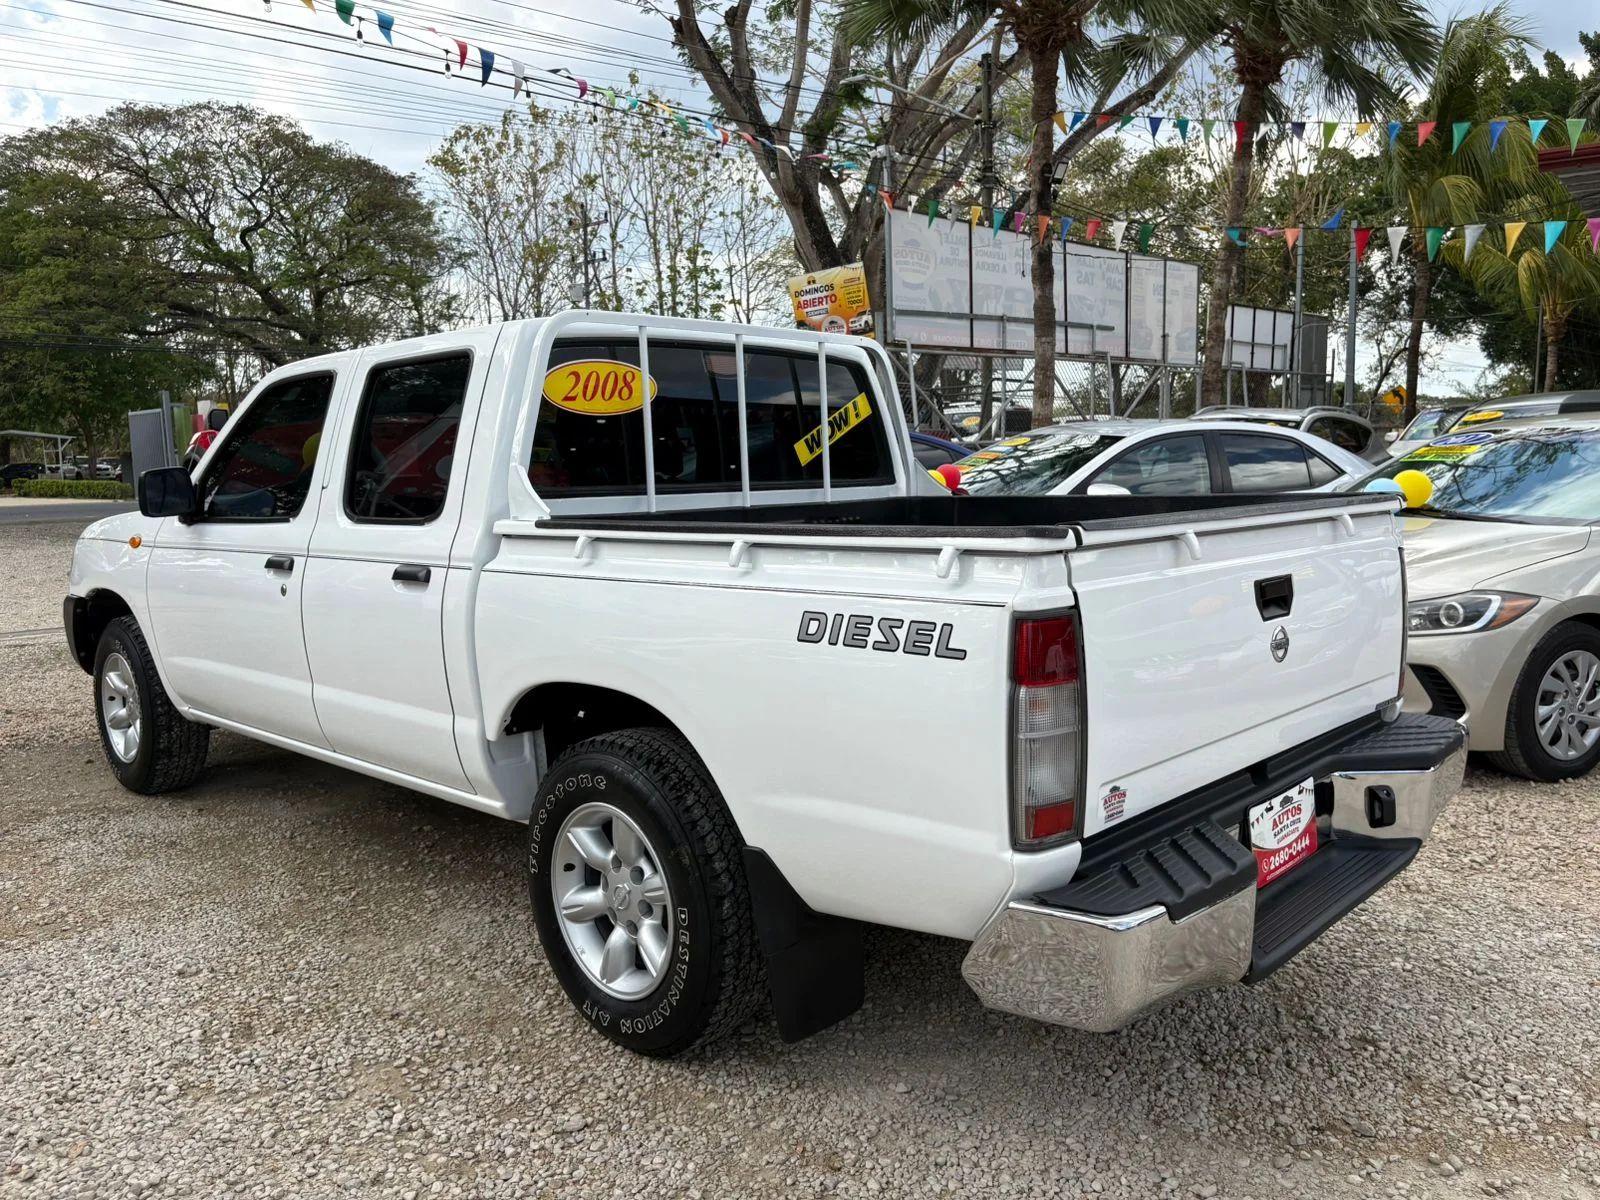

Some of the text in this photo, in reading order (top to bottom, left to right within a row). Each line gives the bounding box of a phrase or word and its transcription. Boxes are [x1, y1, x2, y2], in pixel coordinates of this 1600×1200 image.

[794, 284, 834, 298] DOMINGOS
[796, 293, 837, 311] ABIERTO
[562, 371, 636, 402] 2008
[797, 610, 967, 661] DIESEL
[1103, 791, 1127, 806] AUTOS
[1271, 803, 1303, 832] AUTOS
[1273, 822, 1290, 839] SANTA
[1269, 833, 1310, 871] 2680-0444
[620, 907, 690, 1034] DESTINATION
